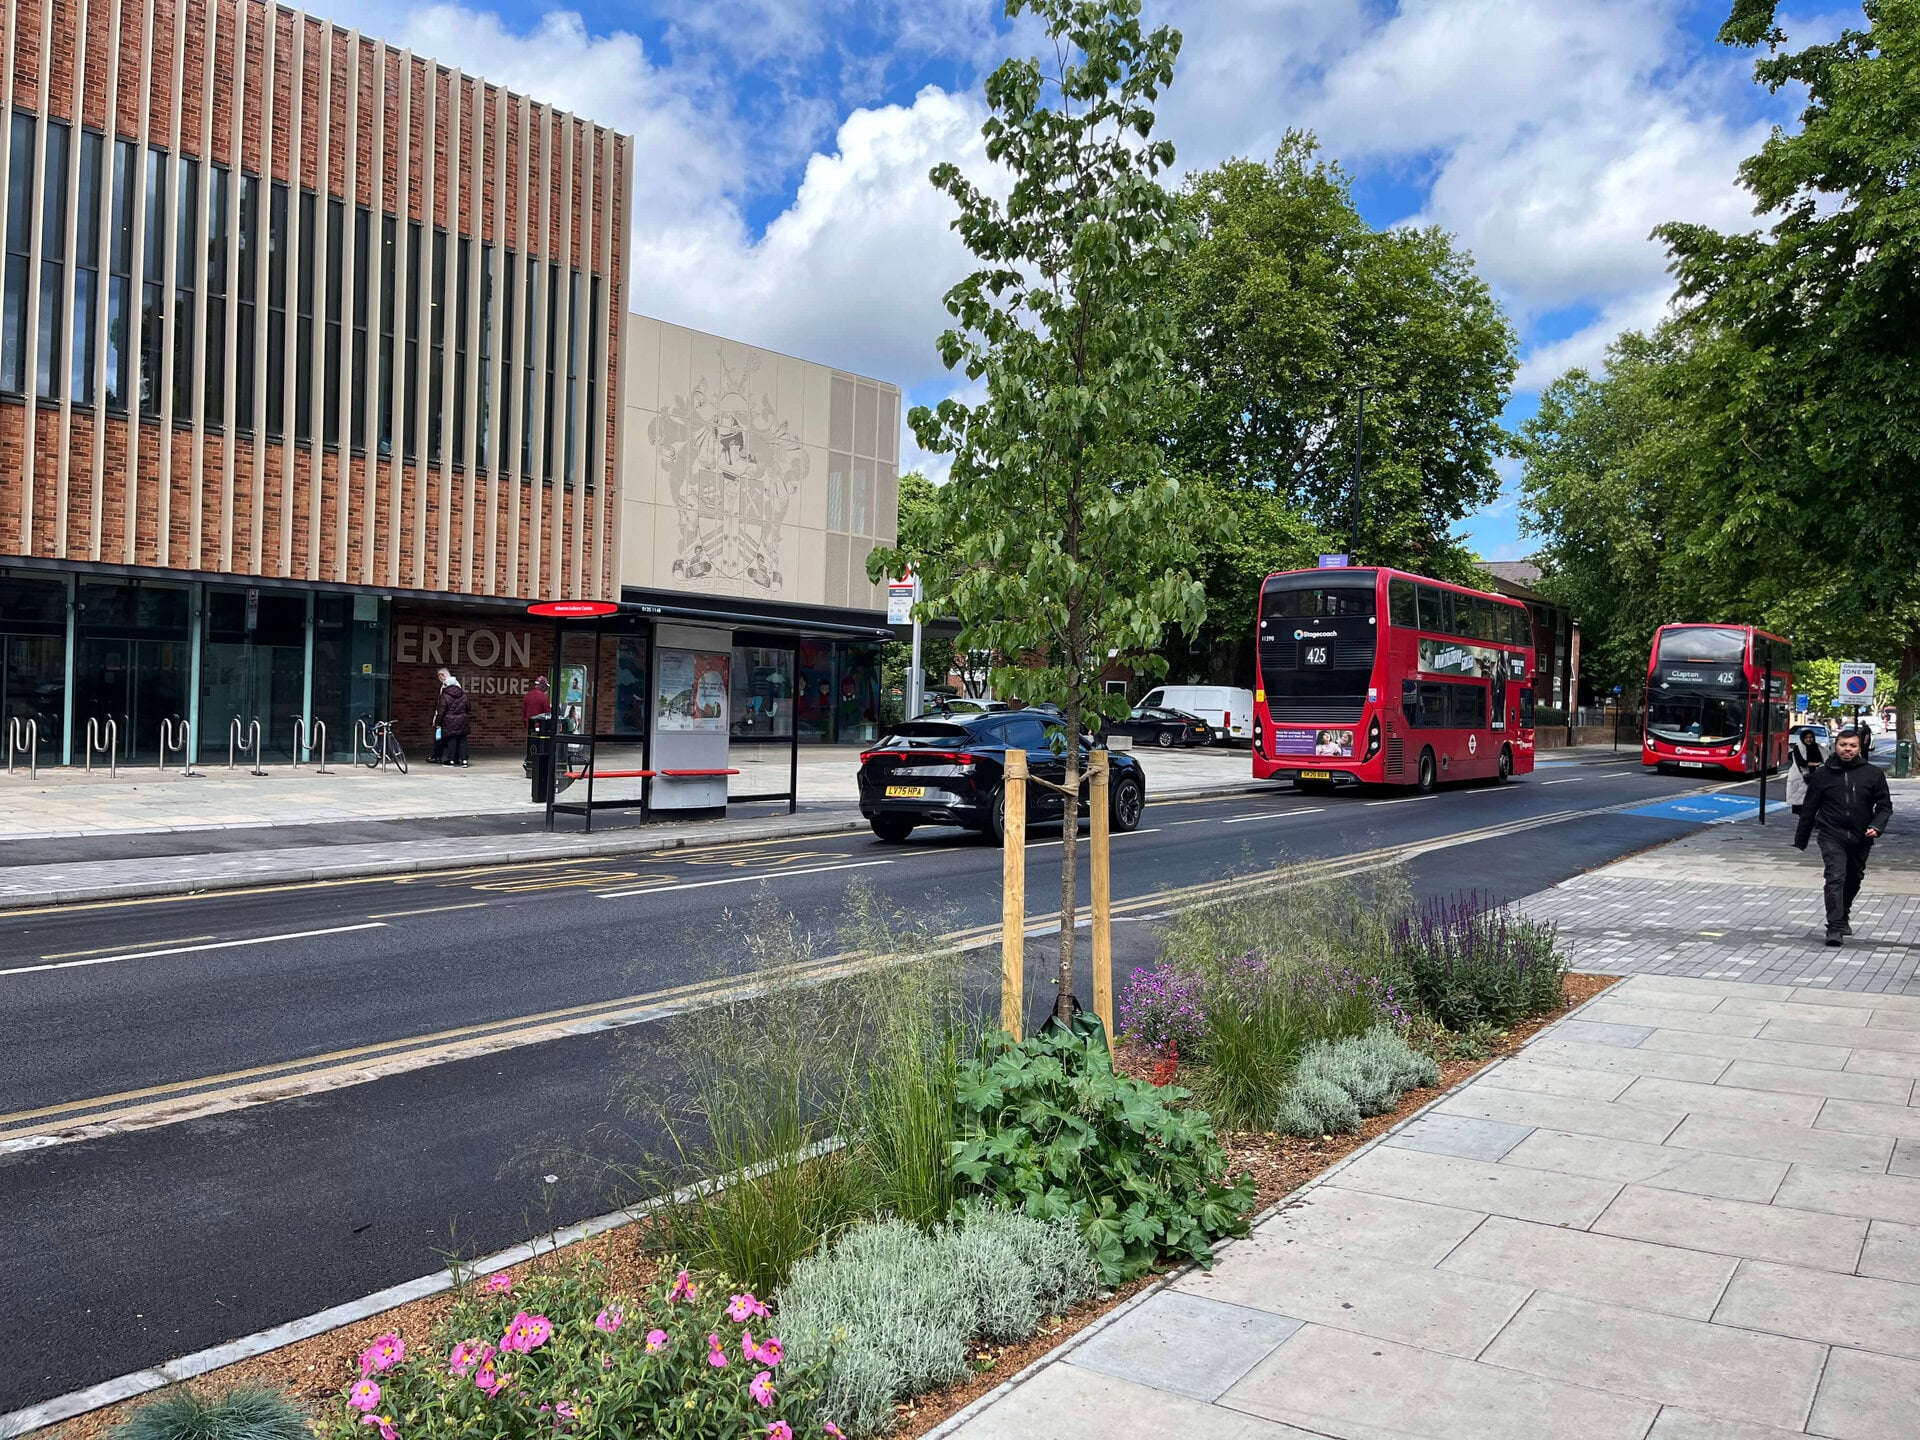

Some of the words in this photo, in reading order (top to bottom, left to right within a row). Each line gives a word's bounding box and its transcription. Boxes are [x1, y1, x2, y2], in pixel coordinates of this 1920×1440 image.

[1303, 630, 1338, 639] Stagecoach
[1306, 647, 1326, 663] 425
[1671, 670, 1699, 678] Clapton
[1717, 672, 1733, 683] 425
[463, 676, 530, 695] LEISURE
[888, 786, 907, 795] LY75
[908, 787, 921, 796] HPA
